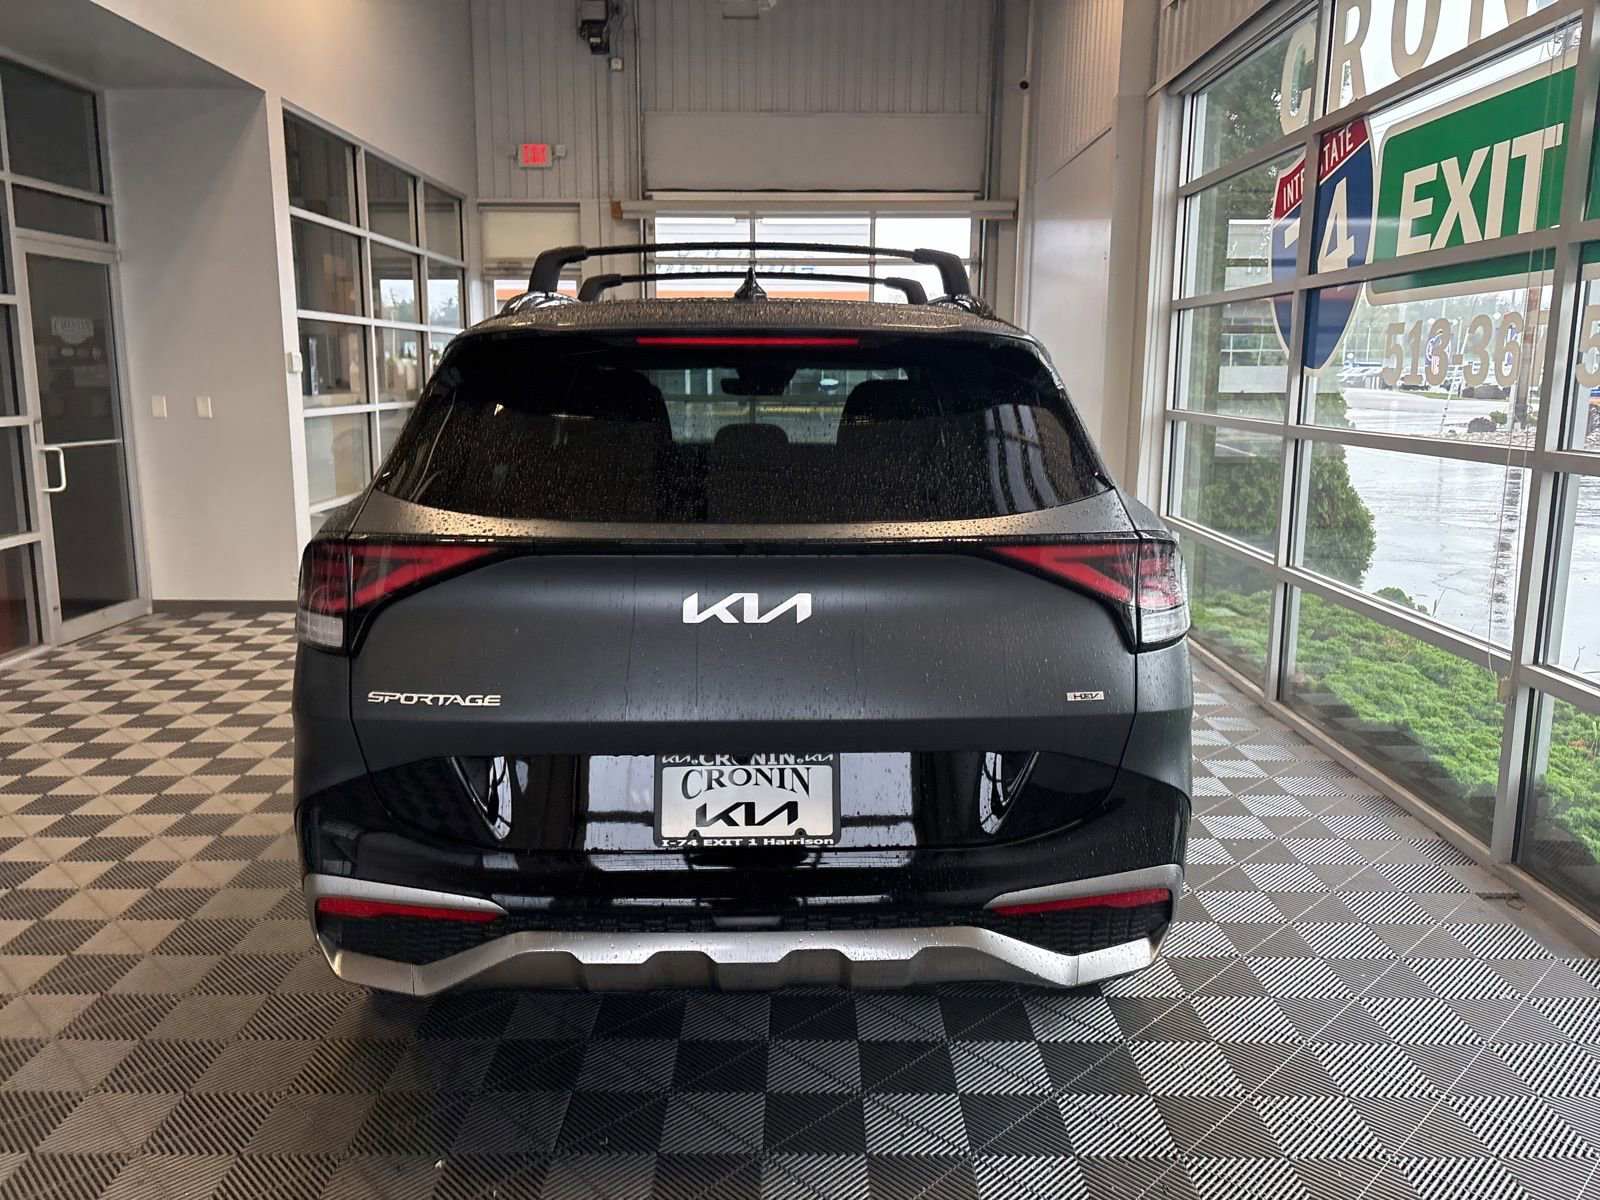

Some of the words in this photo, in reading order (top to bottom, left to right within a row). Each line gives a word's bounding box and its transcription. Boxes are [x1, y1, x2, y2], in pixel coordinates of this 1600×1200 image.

[1396, 123, 1564, 256] EXIT
[682, 592, 812, 624] KIA
[367, 691, 501, 707] SPORTAGE
[699, 753, 795, 766] CRNIN
[681, 767, 812, 800] CRONIN
[695, 801, 799, 827] KIA
[661, 839, 698, 847] I-74
[703, 838, 743, 847] EXIT
[763, 837, 834, 846] Harrison
